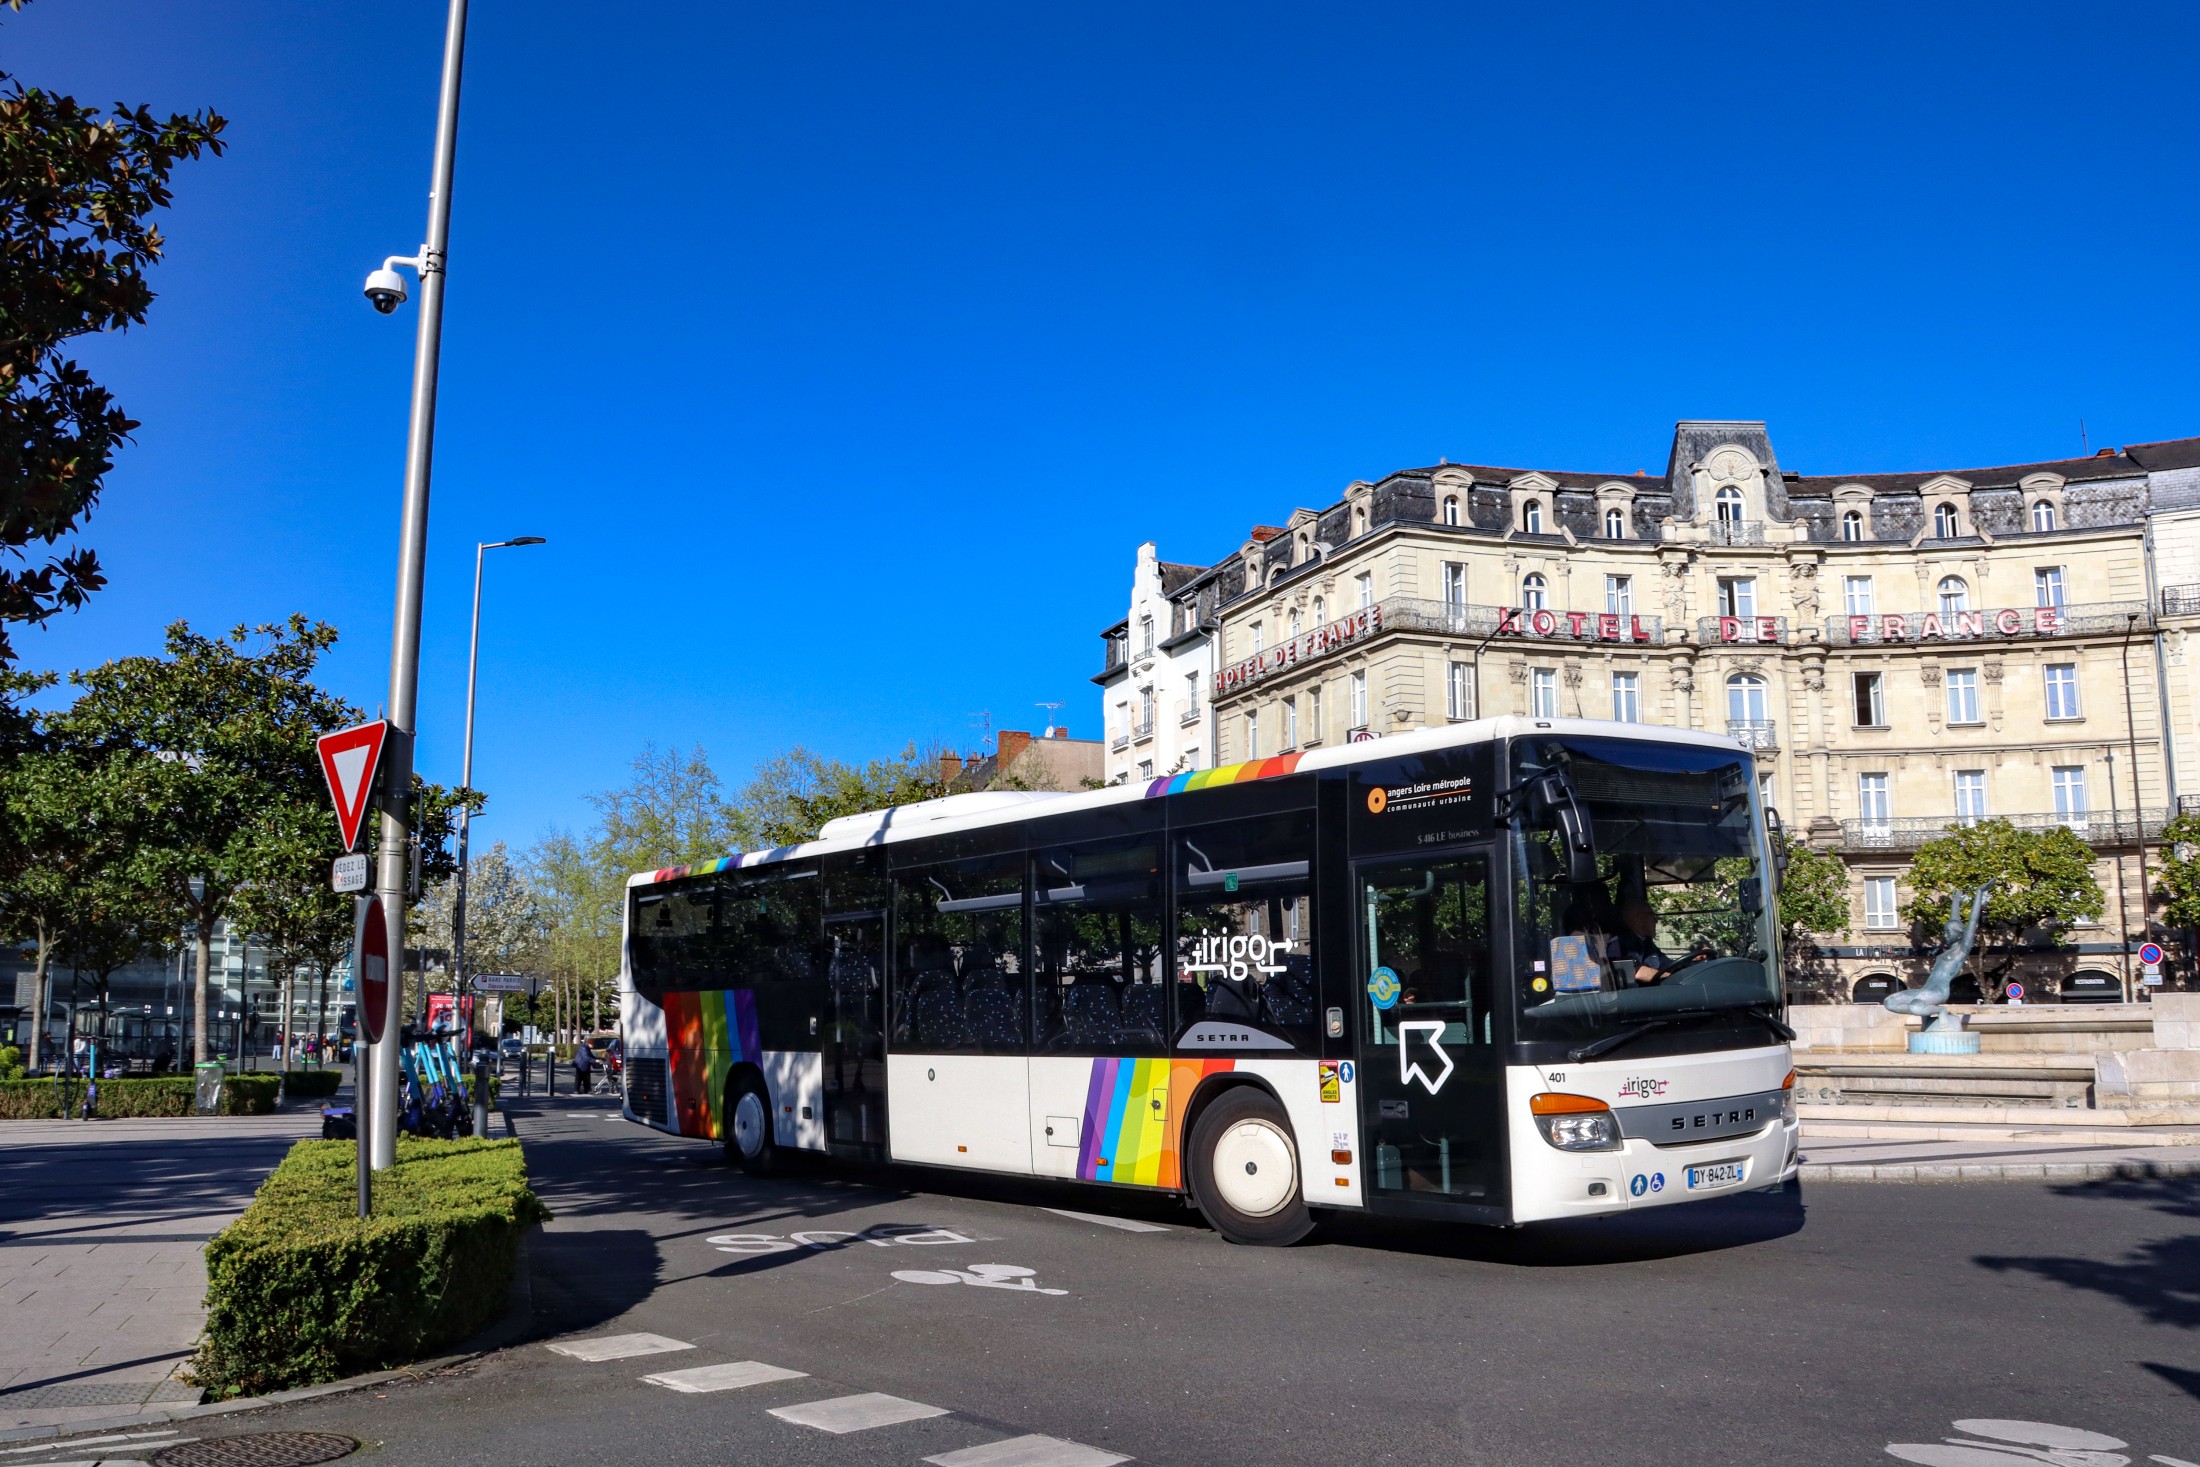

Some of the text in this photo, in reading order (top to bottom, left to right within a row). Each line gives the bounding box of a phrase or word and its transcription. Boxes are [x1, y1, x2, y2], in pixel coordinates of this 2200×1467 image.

[1499, 606, 2059, 641] HOTEL DE FRANCE
[1216, 605, 1383, 690] HOTEL DE FRANCE
[1387, 776, 1471, 798] angers loire métropole
[1387, 794, 1472, 813] communauté urbaine
[1417, 828, 1480, 845] S 416 LE business
[357, 859, 364, 870] LE
[337, 874, 363, 887] SSAGE
[1855, 948, 1864, 957] LA
[1196, 1034, 1249, 1043] SETRA
[1548, 1072, 1566, 1083] 401
[1671, 1108, 1756, 1130] SETRA
[1694, 1165, 1737, 1184] DY-842-ZL
